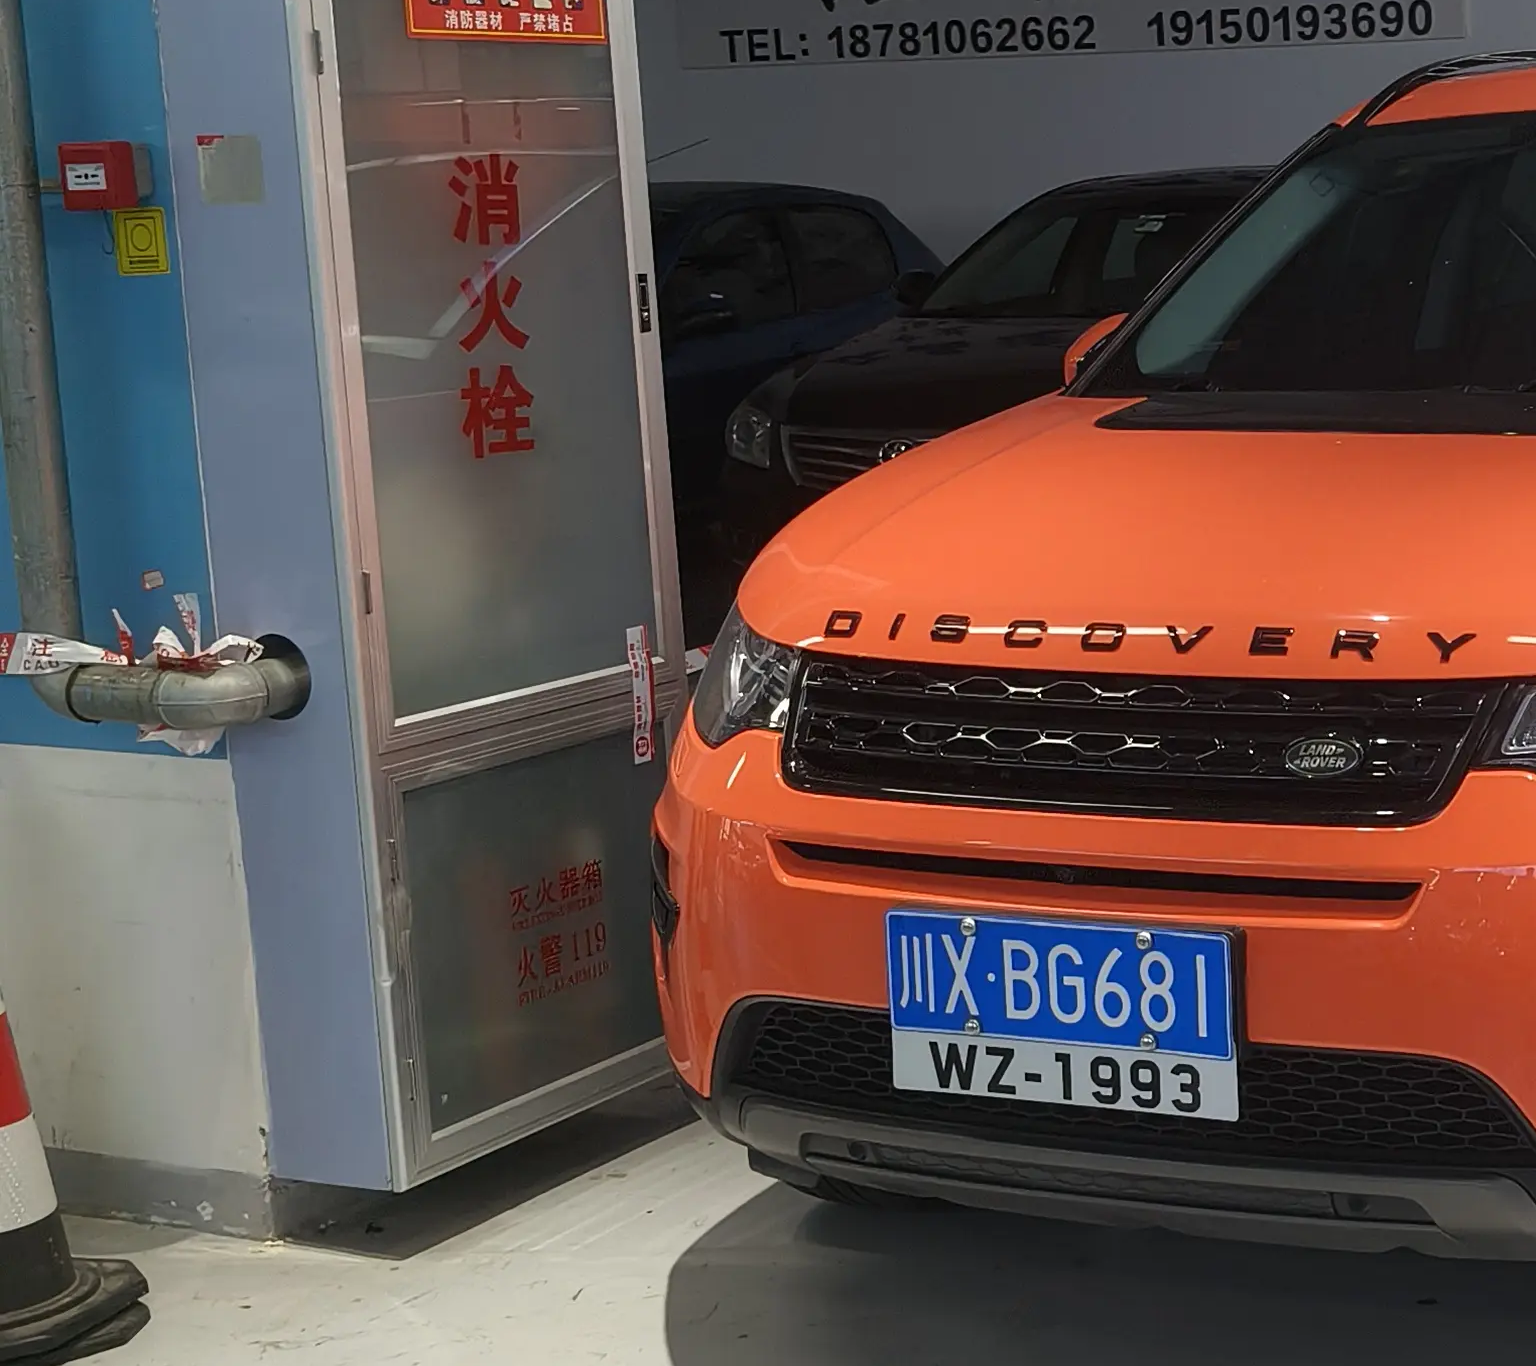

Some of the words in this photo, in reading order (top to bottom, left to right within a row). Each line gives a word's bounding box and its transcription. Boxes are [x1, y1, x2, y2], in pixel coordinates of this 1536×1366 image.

[444, 9, 503, 31] 消防器材
[719, 28, 810, 64] TEL:
[827, 13, 1097, 59] 18781062662
[448, 152, 535, 460] 消火栓
[824, 609, 1477, 664] DISCOVERY
[1299, 744, 1337, 756] LAND
[1300, 756, 1347, 768] ROVER
[509, 859, 603, 918] 灭火器箱
[517, 934, 564, 987] 火警
[572, 921, 607, 961] 119
[928, 1040, 1201, 1113] WZ-1993
